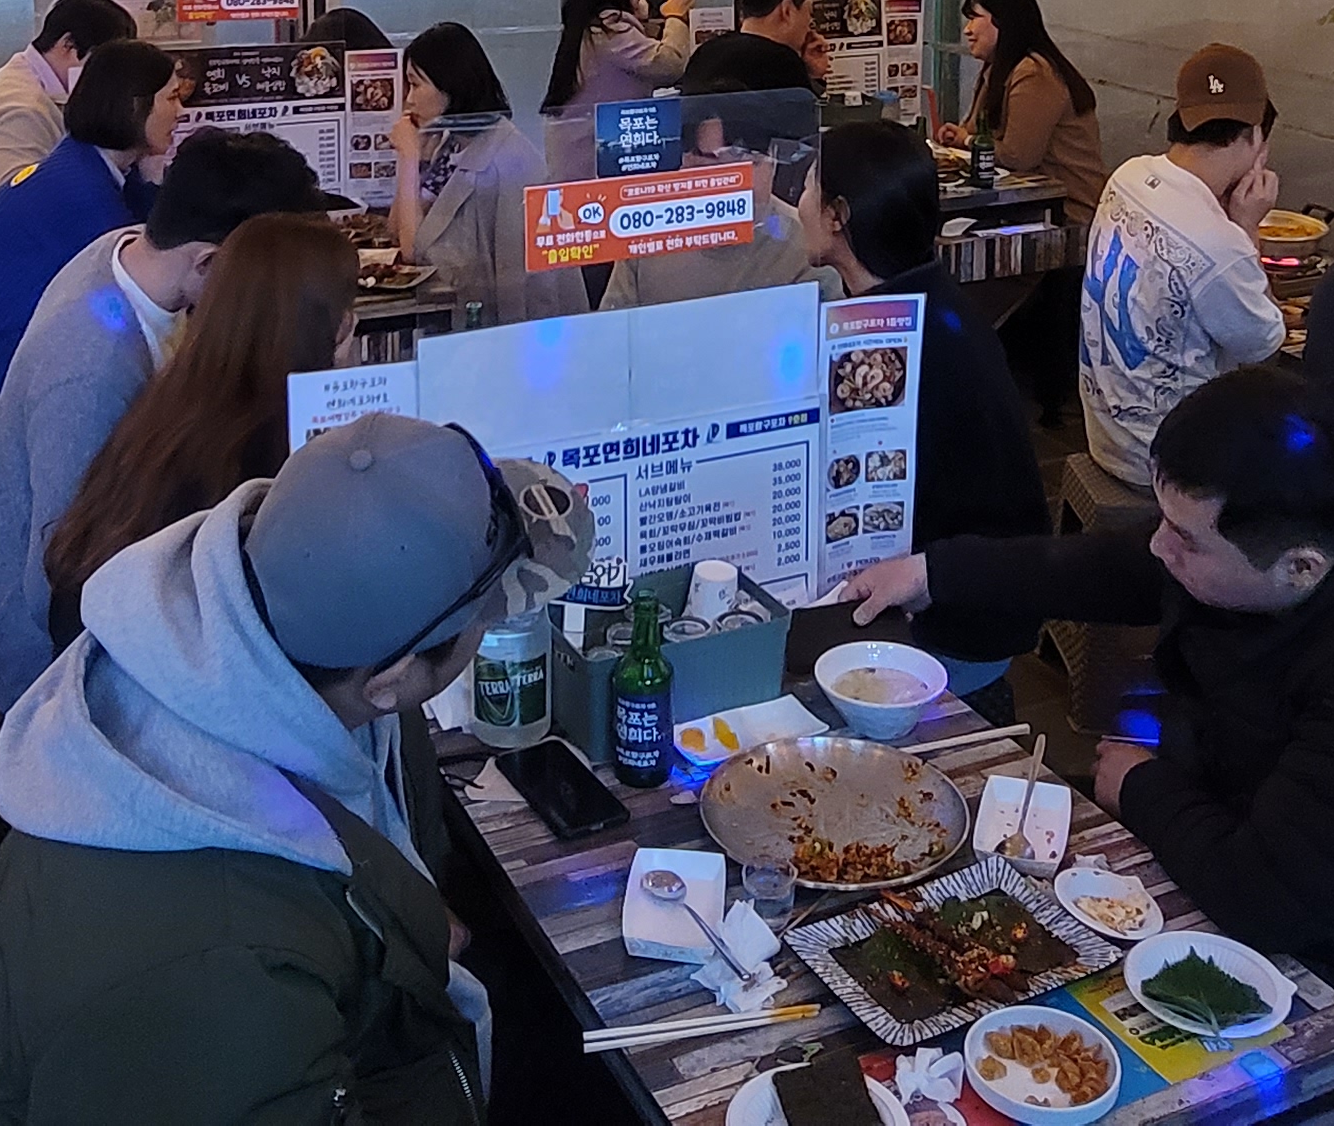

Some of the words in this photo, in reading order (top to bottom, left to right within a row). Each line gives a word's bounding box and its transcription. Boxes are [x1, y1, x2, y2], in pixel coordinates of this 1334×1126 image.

[235, 74, 251, 88] VS
[1208, 75, 1224, 93] LA
[619, 115, 658, 134] 목포는
[582, 206, 603, 221] OK
[619, 197, 747, 231] 080-283-9848
[628, 237, 664, 255] 개인별로
[665, 234, 684, 251] 전화
[685, 230, 739, 248] 부탁드립니다.
[561, 426, 700, 471] 목포연희네포차
[635, 457, 694, 481] 서브메뉴
[638, 480, 686, 498] LA양념갈비
[771, 458, 802, 472] 38,000
[772, 472, 802, 486] 35,000
[771, 486, 802, 500] 20,000
[771, 500, 802, 514] 20,000
[771, 513, 802, 527] 20,000
[772, 526, 802, 540] 10,000
[777, 539, 802, 554] 2,500
[776, 553, 802, 567] 2,000
[478, 679, 512, 696] TERRA
